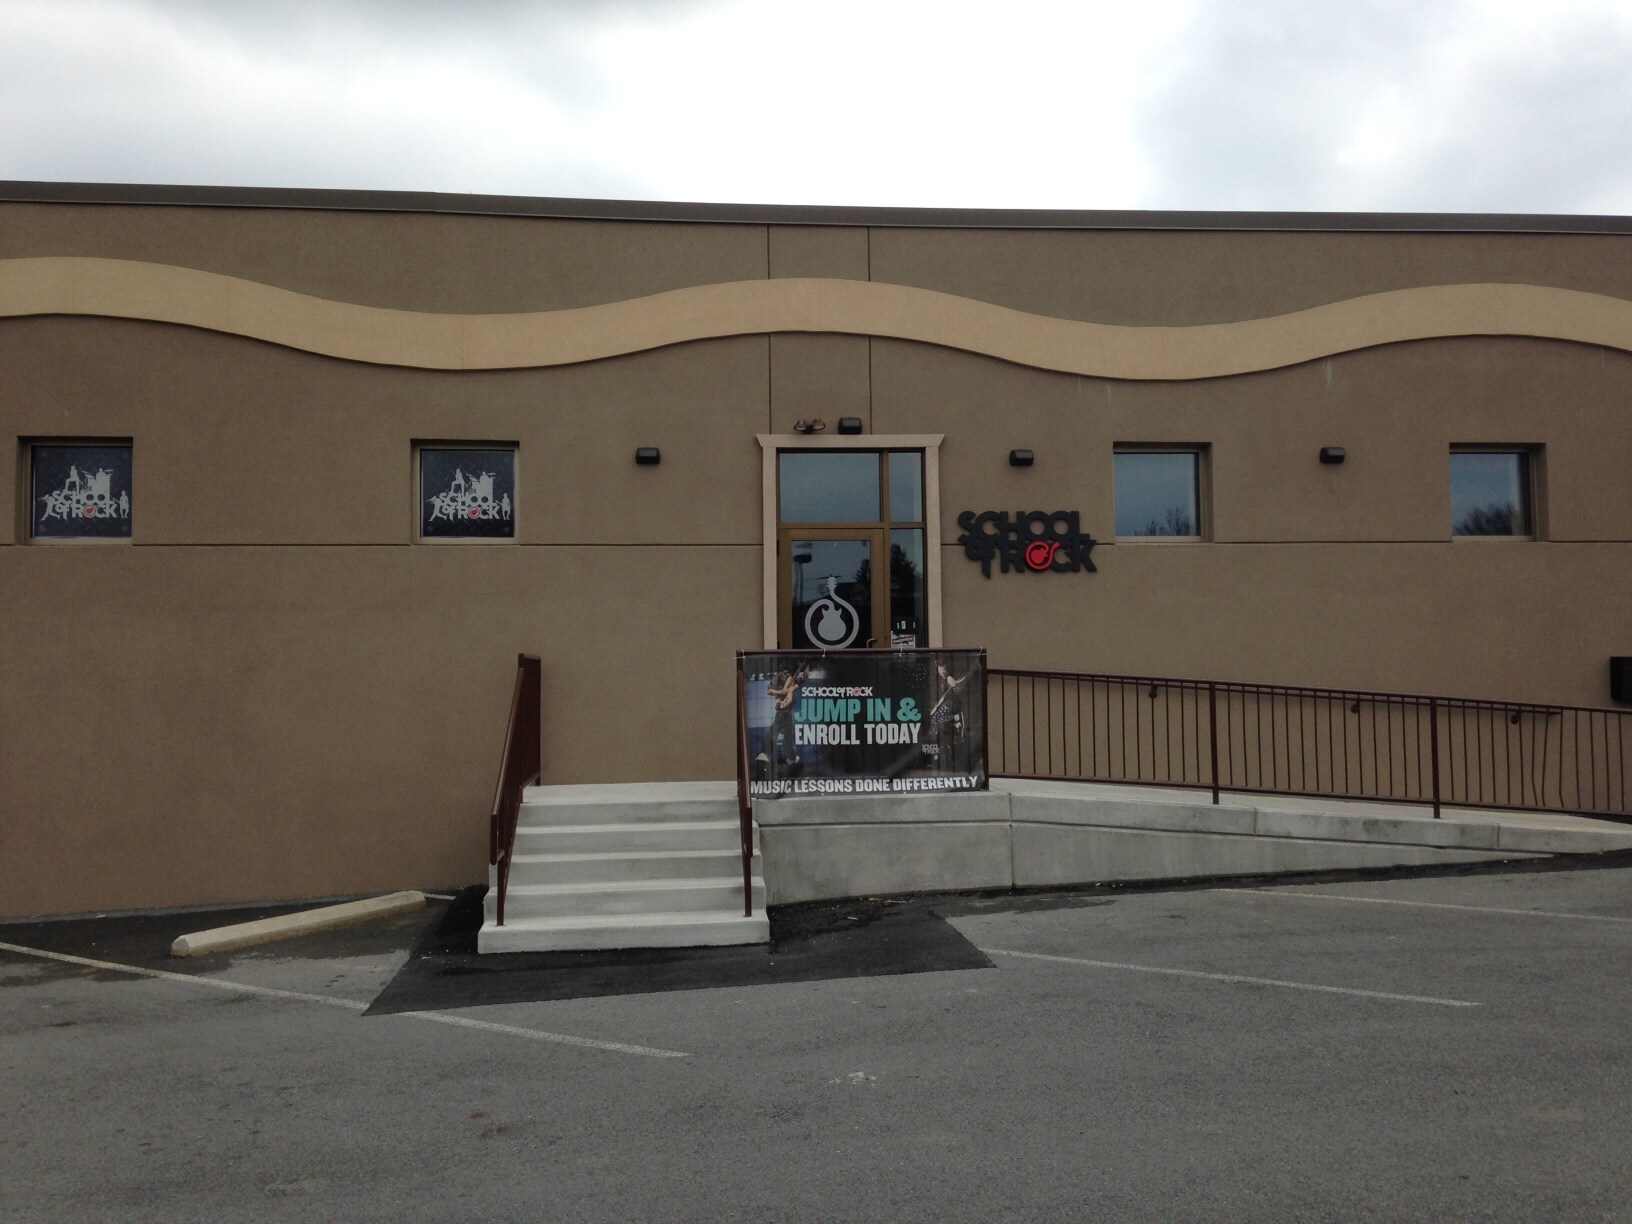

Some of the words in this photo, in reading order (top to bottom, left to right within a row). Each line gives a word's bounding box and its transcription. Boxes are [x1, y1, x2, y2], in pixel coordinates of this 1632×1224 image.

[957, 511, 1090, 543] SCHOOL
[1000, 540, 1097, 573] ROCK
[794, 698, 861, 722] JUMP
[867, 698, 891, 721] IN
[897, 697, 921, 721] &
[794, 723, 860, 745] ENROLL
[864, 723, 921, 744] TODAY
[751, 780, 791, 794] MUSIC
[794, 779, 852, 793] LESSONS
[855, 779, 890, 792] DONE
[892, 775, 978, 791] DIFFERENTLY
